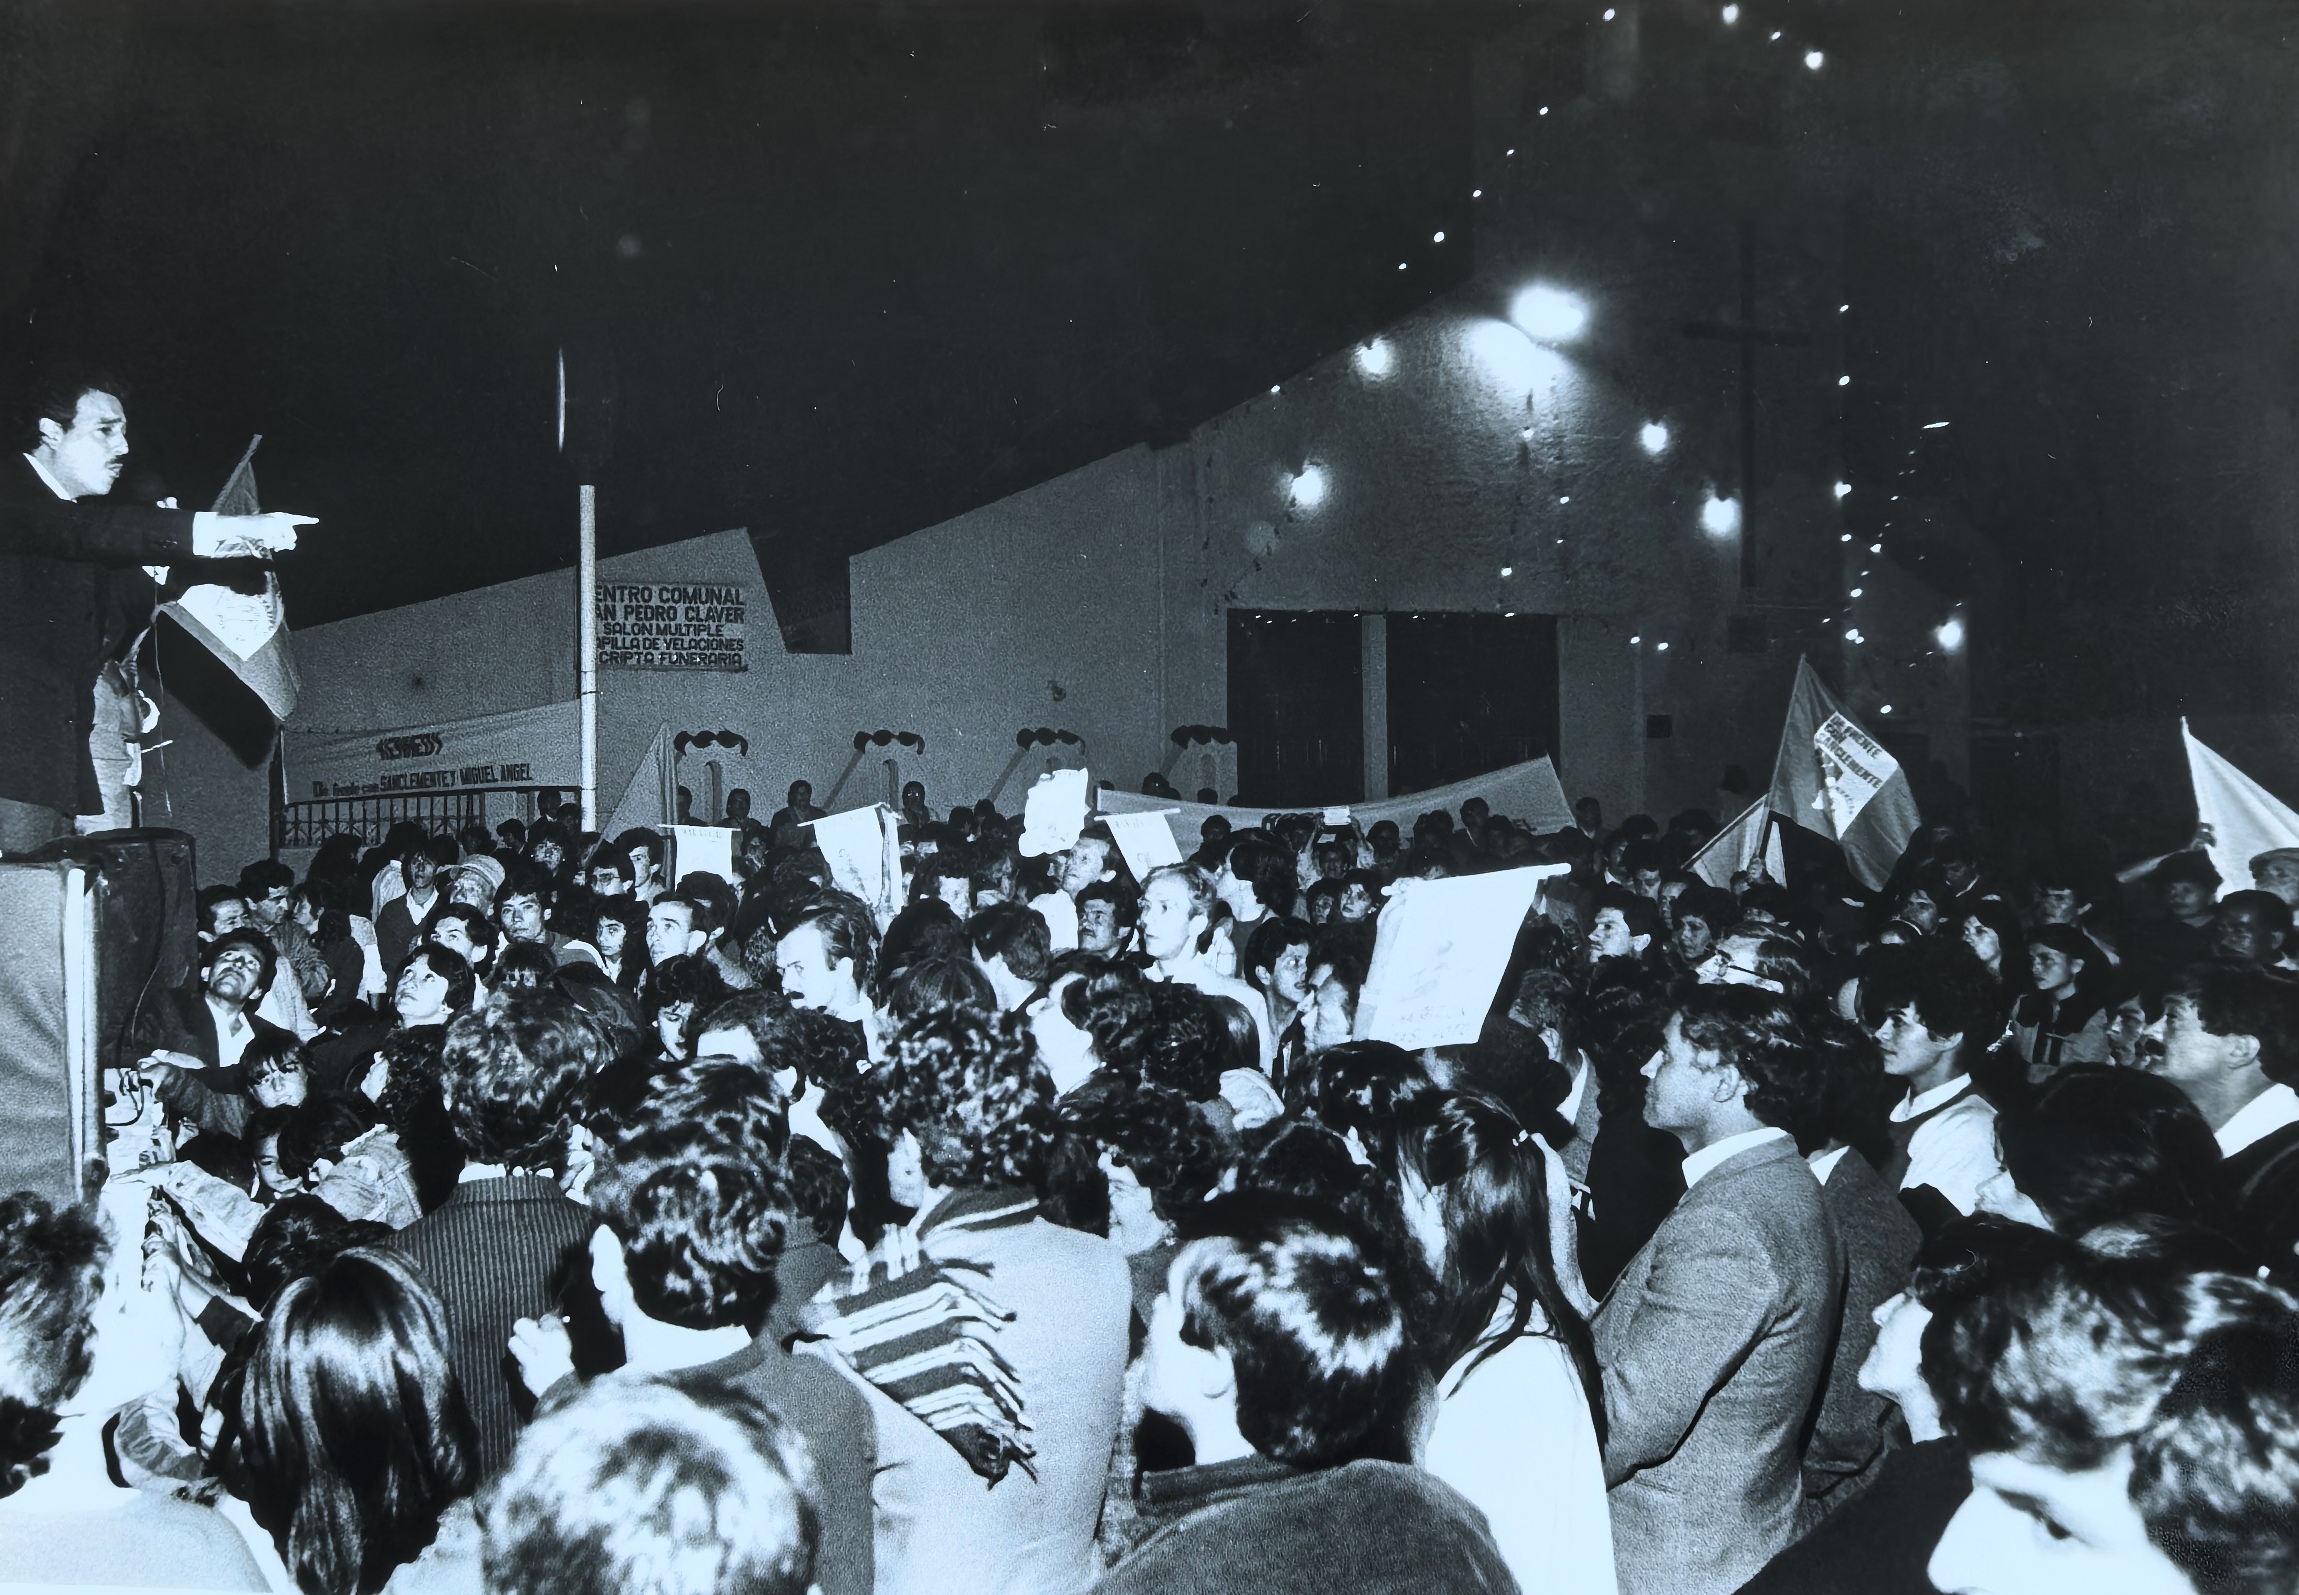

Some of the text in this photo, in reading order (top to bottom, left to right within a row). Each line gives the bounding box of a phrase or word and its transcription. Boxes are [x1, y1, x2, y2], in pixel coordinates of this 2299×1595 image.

[595, 586, 744, 605] ENTRO COMUNAL
[595, 604, 744, 623] AN PEDRO CLAVER
[603, 622, 723, 637] SALON MULTIPLE
[643, 637, 660, 650] DE
[663, 638, 744, 651] VELACIONES
[599, 651, 741, 666] CRIPTA FUNERARIA
[501, 763, 533, 782] ANGEL
